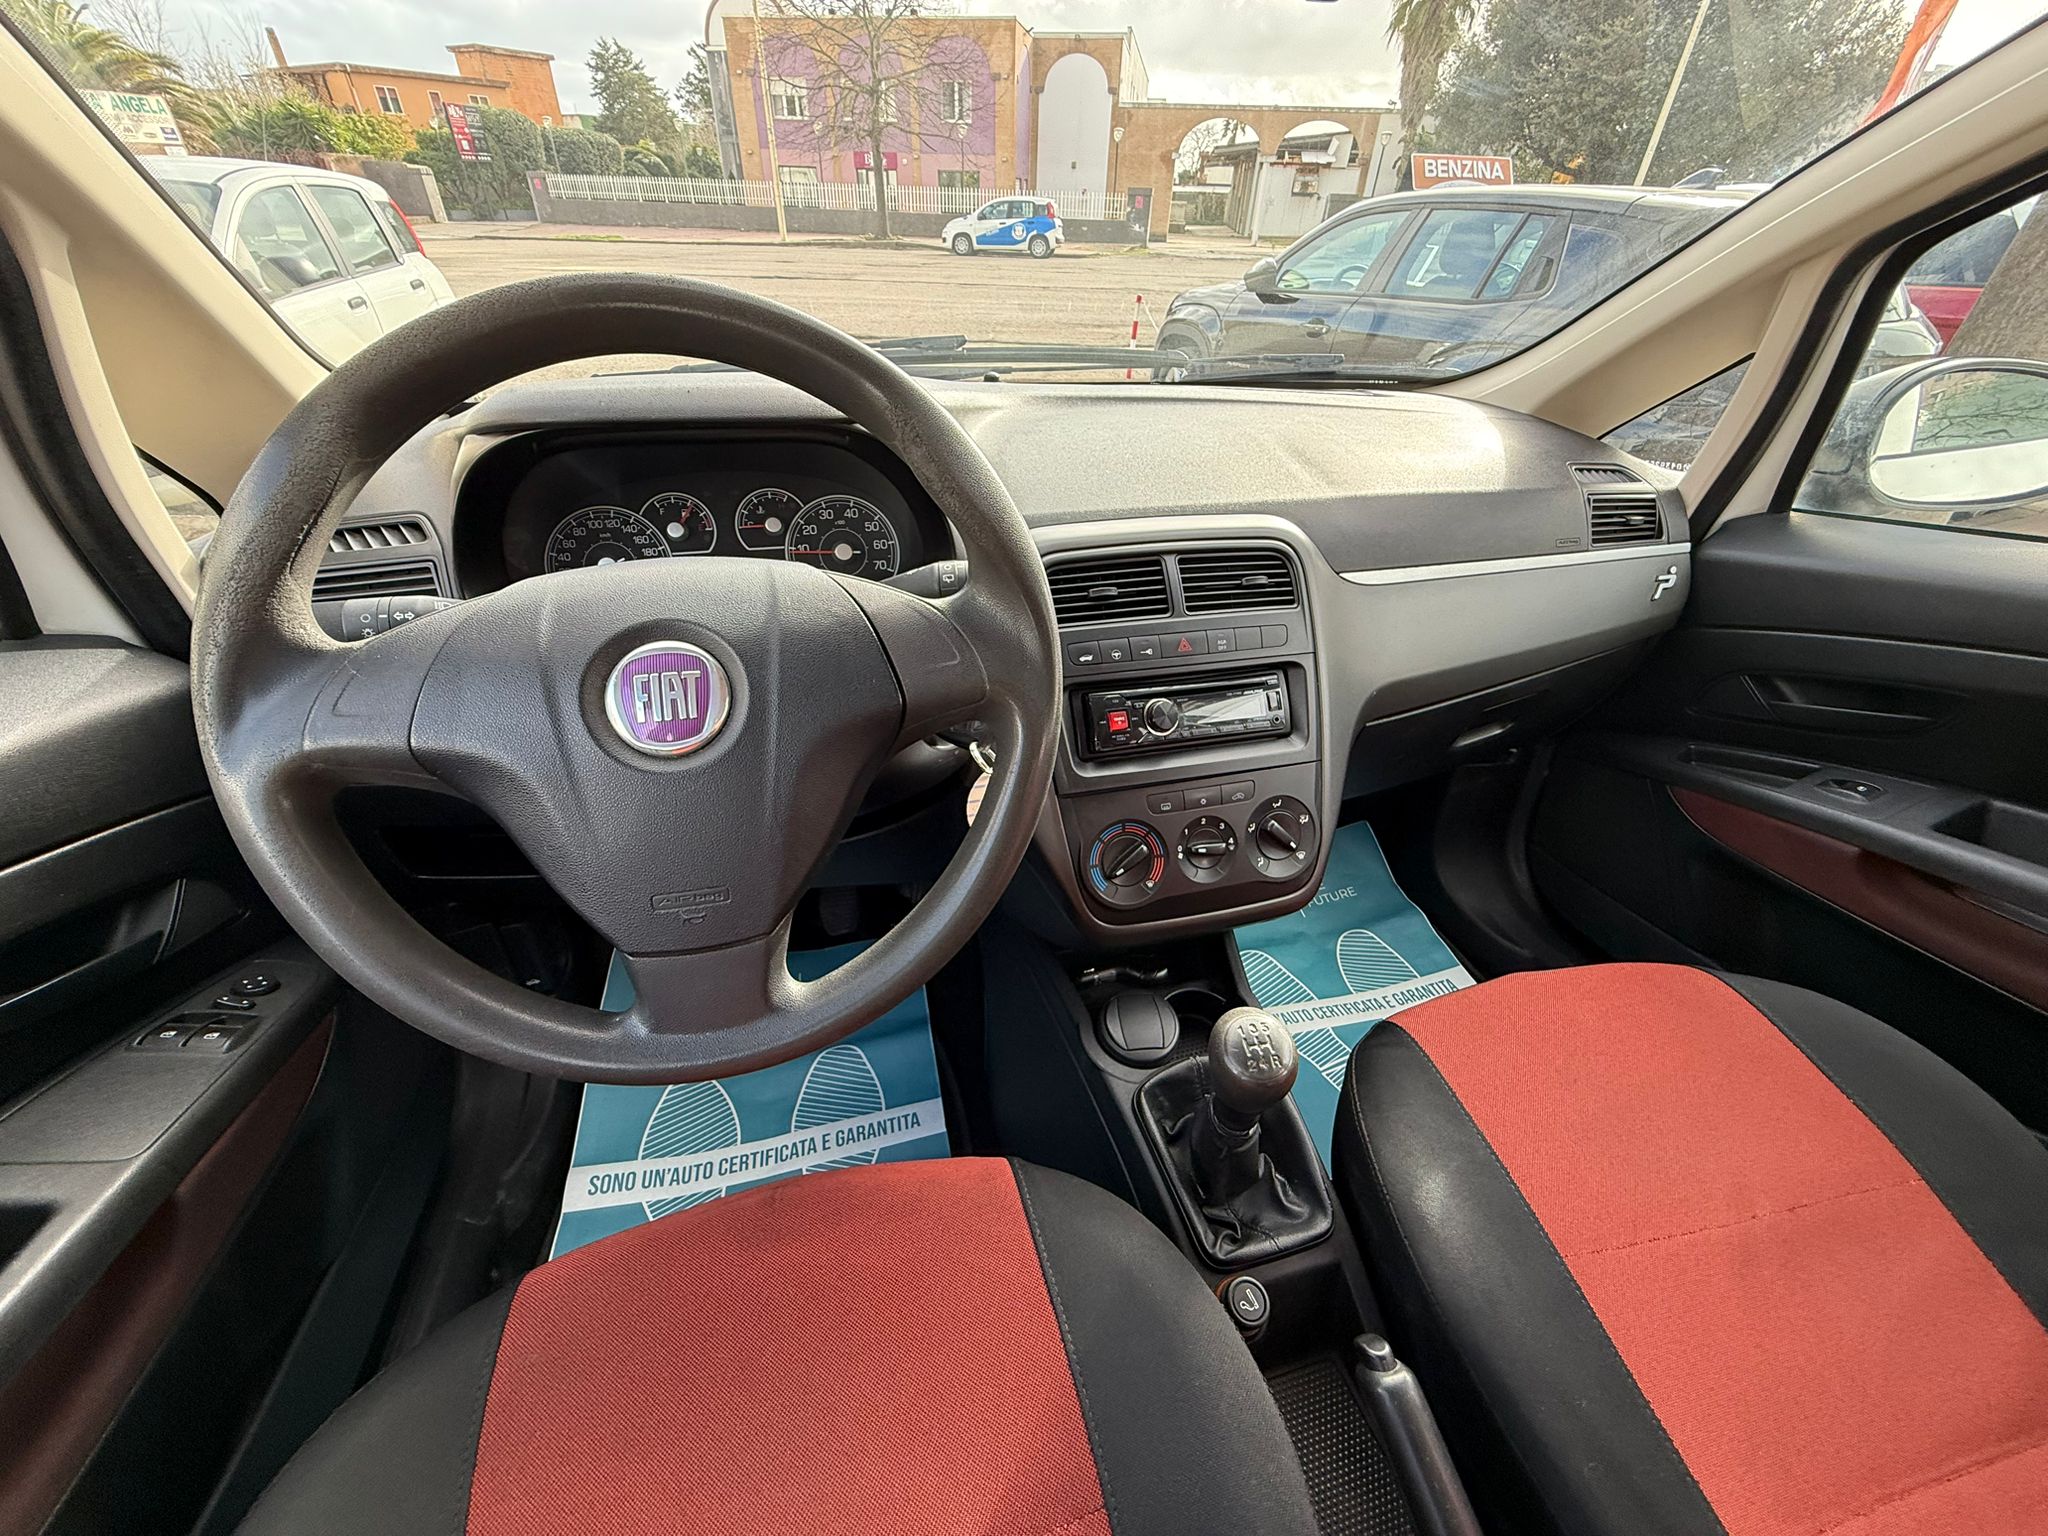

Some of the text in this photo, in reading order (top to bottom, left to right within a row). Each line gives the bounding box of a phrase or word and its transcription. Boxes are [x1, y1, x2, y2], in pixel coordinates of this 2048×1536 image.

[110, 95, 168, 115] ANGELA
[1423, 158, 1505, 180] BENZINA
[819, 509, 834, 520] 30
[843, 508, 859, 518] 40
[586, 520, 603, 529] 100
[604, 519, 620, 528] 120
[621, 524, 638, 533] 140
[864, 521, 880, 532] 50
[572, 527, 586, 536] 80
[802, 525, 818, 535] 20
[562, 539, 576, 548] 60
[633, 536, 650, 544] 160
[873, 539, 888, 550] 60
[557, 553, 572, 561] 40
[642, 548, 659, 557] 180
[872, 560, 887, 570] 70
[633, 670, 701, 723] FIAT
[1200, 817, 1207, 825] 2
[1219, 822, 1225, 830] 3
[1313, 998, 1387, 1020] CERTIFICATA
[1383, 995, 1396, 1009] E
[1393, 978, 1461, 1006] GARANTITA
[1237, 1025, 1245, 1037] 1
[1270, 1054, 1282, 1069] R
[588, 1111, 921, 1196] SONO UN'AUTO CERTIFICATA E GARANTITA
